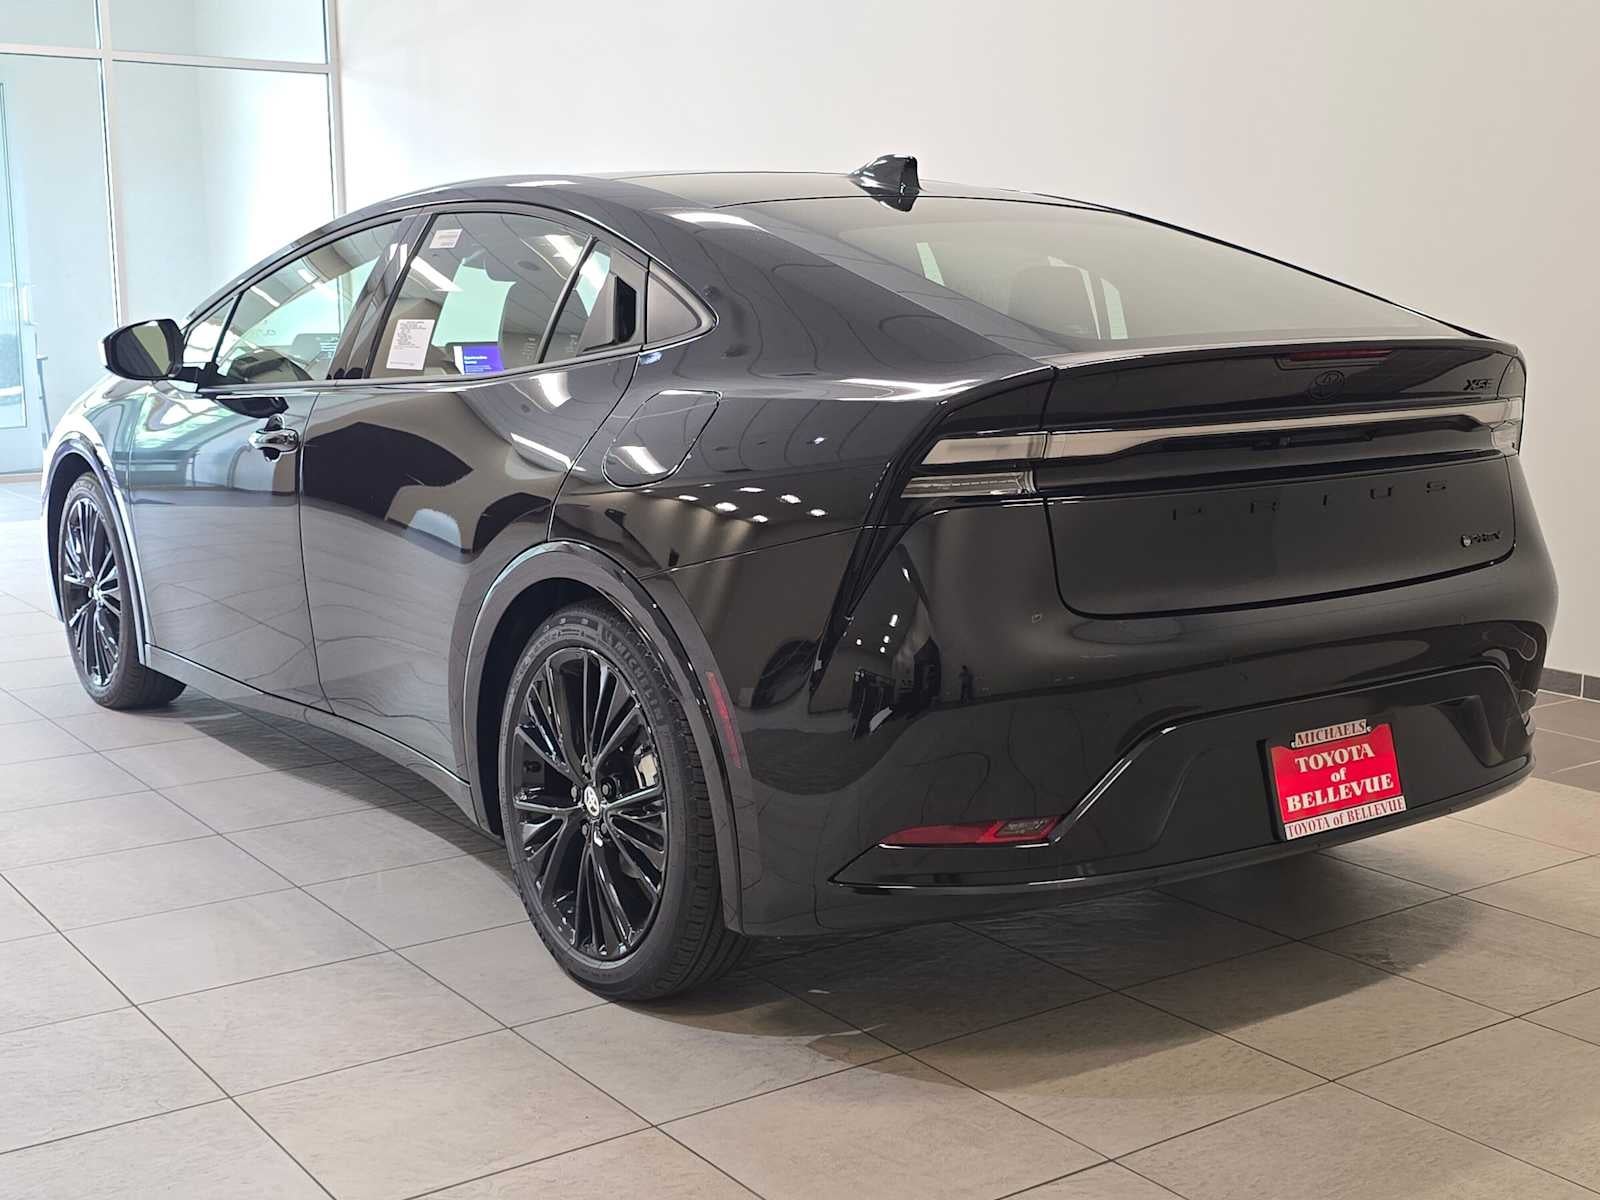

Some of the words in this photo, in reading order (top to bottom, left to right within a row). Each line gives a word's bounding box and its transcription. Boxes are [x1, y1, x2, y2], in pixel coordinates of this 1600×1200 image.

[1463, 378, 1493, 391] XSE
[1296, 720, 1366, 746] MICHAELS
[1295, 743, 1375, 773] TOYOTA
[1330, 767, 1347, 783] of
[1286, 773, 1394, 813] BELLEVUE
[1287, 817, 1331, 839] TOYOTA
[1333, 813, 1345, 826] of
[1347, 797, 1405, 823] BELLEVUE
